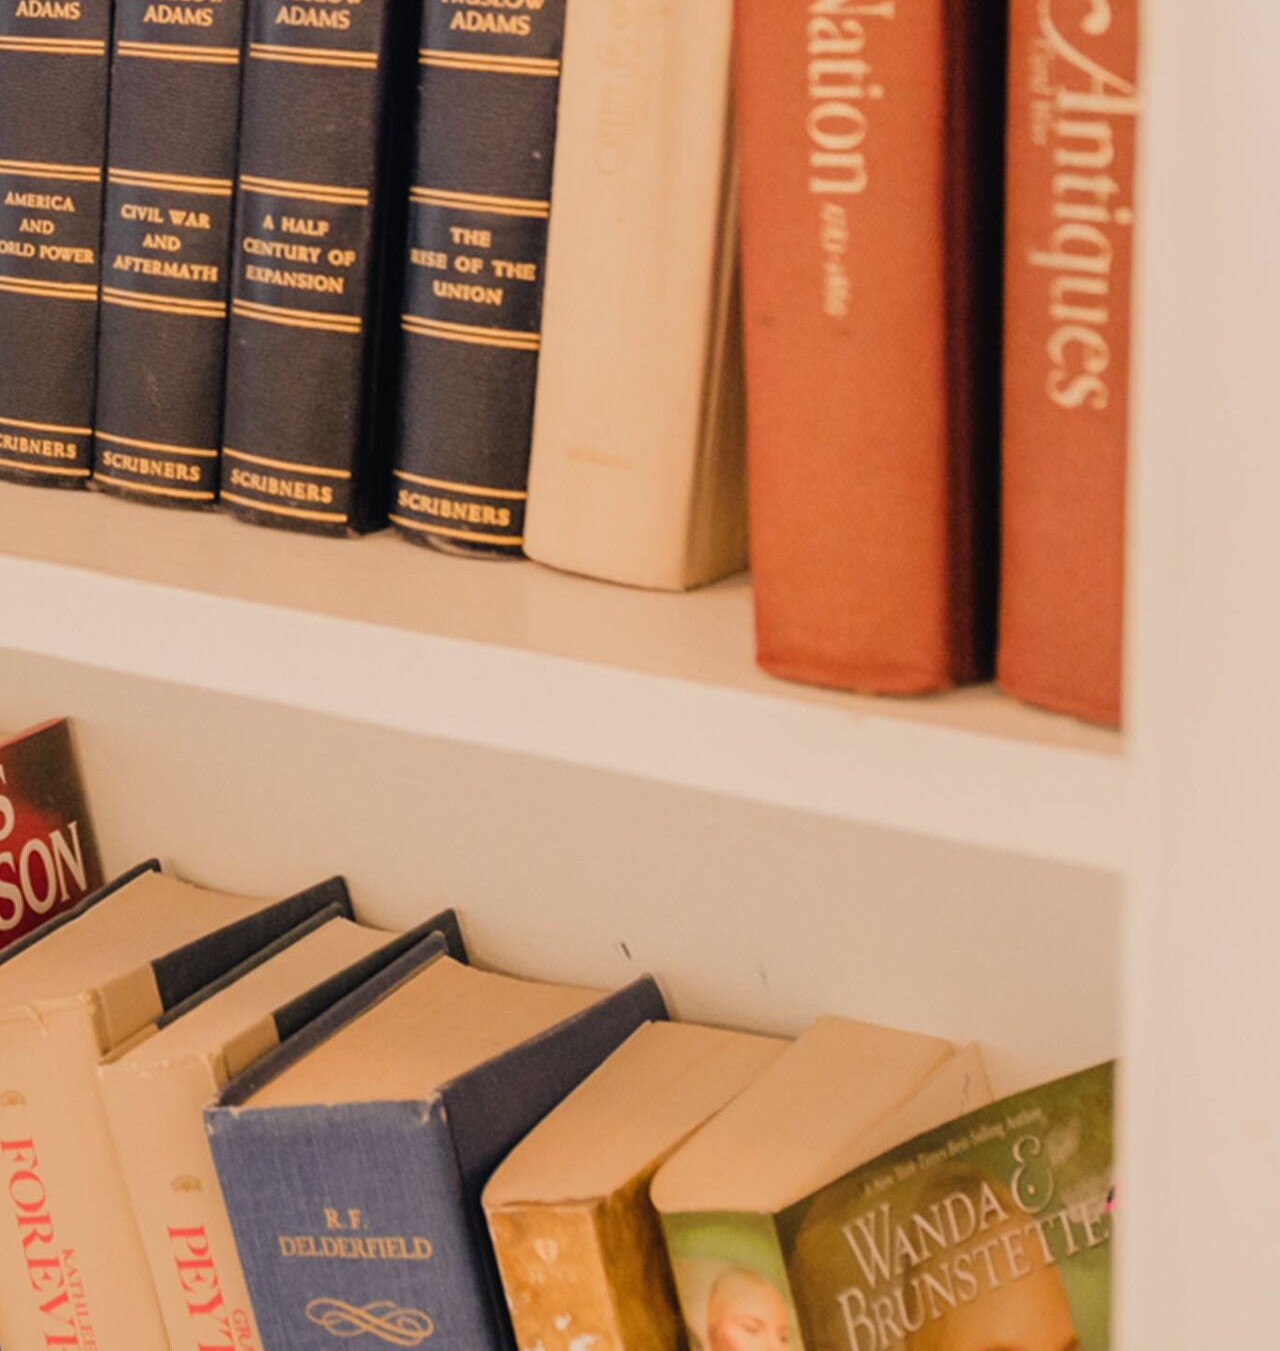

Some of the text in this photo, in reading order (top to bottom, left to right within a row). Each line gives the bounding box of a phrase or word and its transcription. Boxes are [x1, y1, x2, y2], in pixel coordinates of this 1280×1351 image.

[15, 0, 81, 21] ADAMS
[143, 5, 214, 27] ADAMS
[275, 6, 351, 31] ADAMS
[449, 10, 531, 36] ADAMS
[4, 191, 75, 213] AMERICA
[19, 218, 55, 235] AND
[120, 203, 211, 230] CIVIL WAR
[263, 214, 330, 237] A HALF
[142, 233, 181, 252] AND
[449, 226, 492, 248] THE
[39, 245, 94, 265] POWER
[243, 236, 356, 268] CENTURY OF
[410, 248, 537, 281] RISE OF THE
[113, 255, 218, 282] AFTERMATH
[245, 264, 344, 295] EXPANSION
[432, 280, 504, 306] UNION
[102, 451, 201, 482] SCRIBNERS
[230, 468, 333, 505] SCRIBNERS
[397, 489, 511, 527] SCRIBNERS
[278, 1234, 433, 1261] DELDERFIELD
[841, 1180, 1009, 1291] WANDA
[836, 1200, 1111, 1351] BRUNSTETTE
